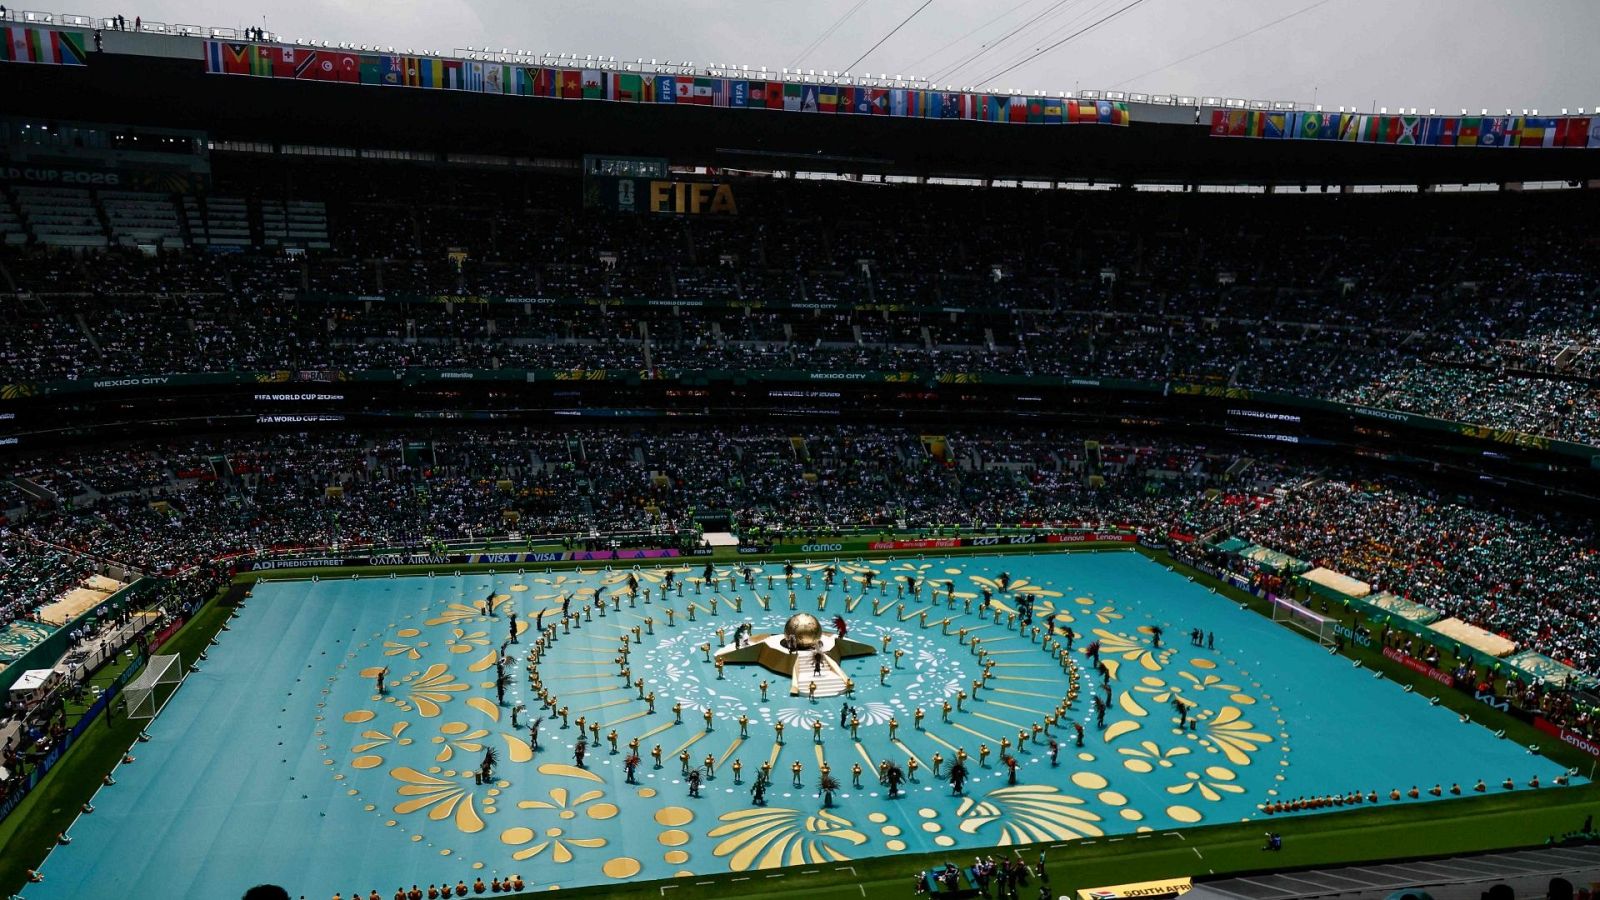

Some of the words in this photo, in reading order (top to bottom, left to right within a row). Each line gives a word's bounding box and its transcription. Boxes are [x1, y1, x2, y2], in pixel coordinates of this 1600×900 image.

[663, 79, 671, 100] FIFA
[735, 83, 743, 104] FIFA
[24, 167, 58, 182] CUP
[61, 171, 120, 185] 2026
[649, 179, 738, 215] FIFA
[94, 378, 140, 389] MEXICO
[141, 377, 169, 385] CITY
[274, 415, 302, 423] WORLD
[1355, 407, 1388, 419] MEXICO
[1388, 412, 1409, 421] CITY
[973, 537, 999, 546] KIA
[1010, 535, 1036, 545] KIA
[1059, 534, 1085, 542] Lenovo
[802, 542, 843, 552] aramco
[370, 556, 404, 566] QATAR
[408, 554, 451, 565] AIRWAYS
[487, 554, 510, 563] VISA
[534, 552, 556, 562] VISA
[252, 562, 275, 571] ADI
[277, 559, 345, 568] PREDICTSTREET
[1560, 729, 1600, 756] Lenovo
[1123, 885, 1164, 897] SOUTH
[1166, 883, 1192, 893] AFRI
